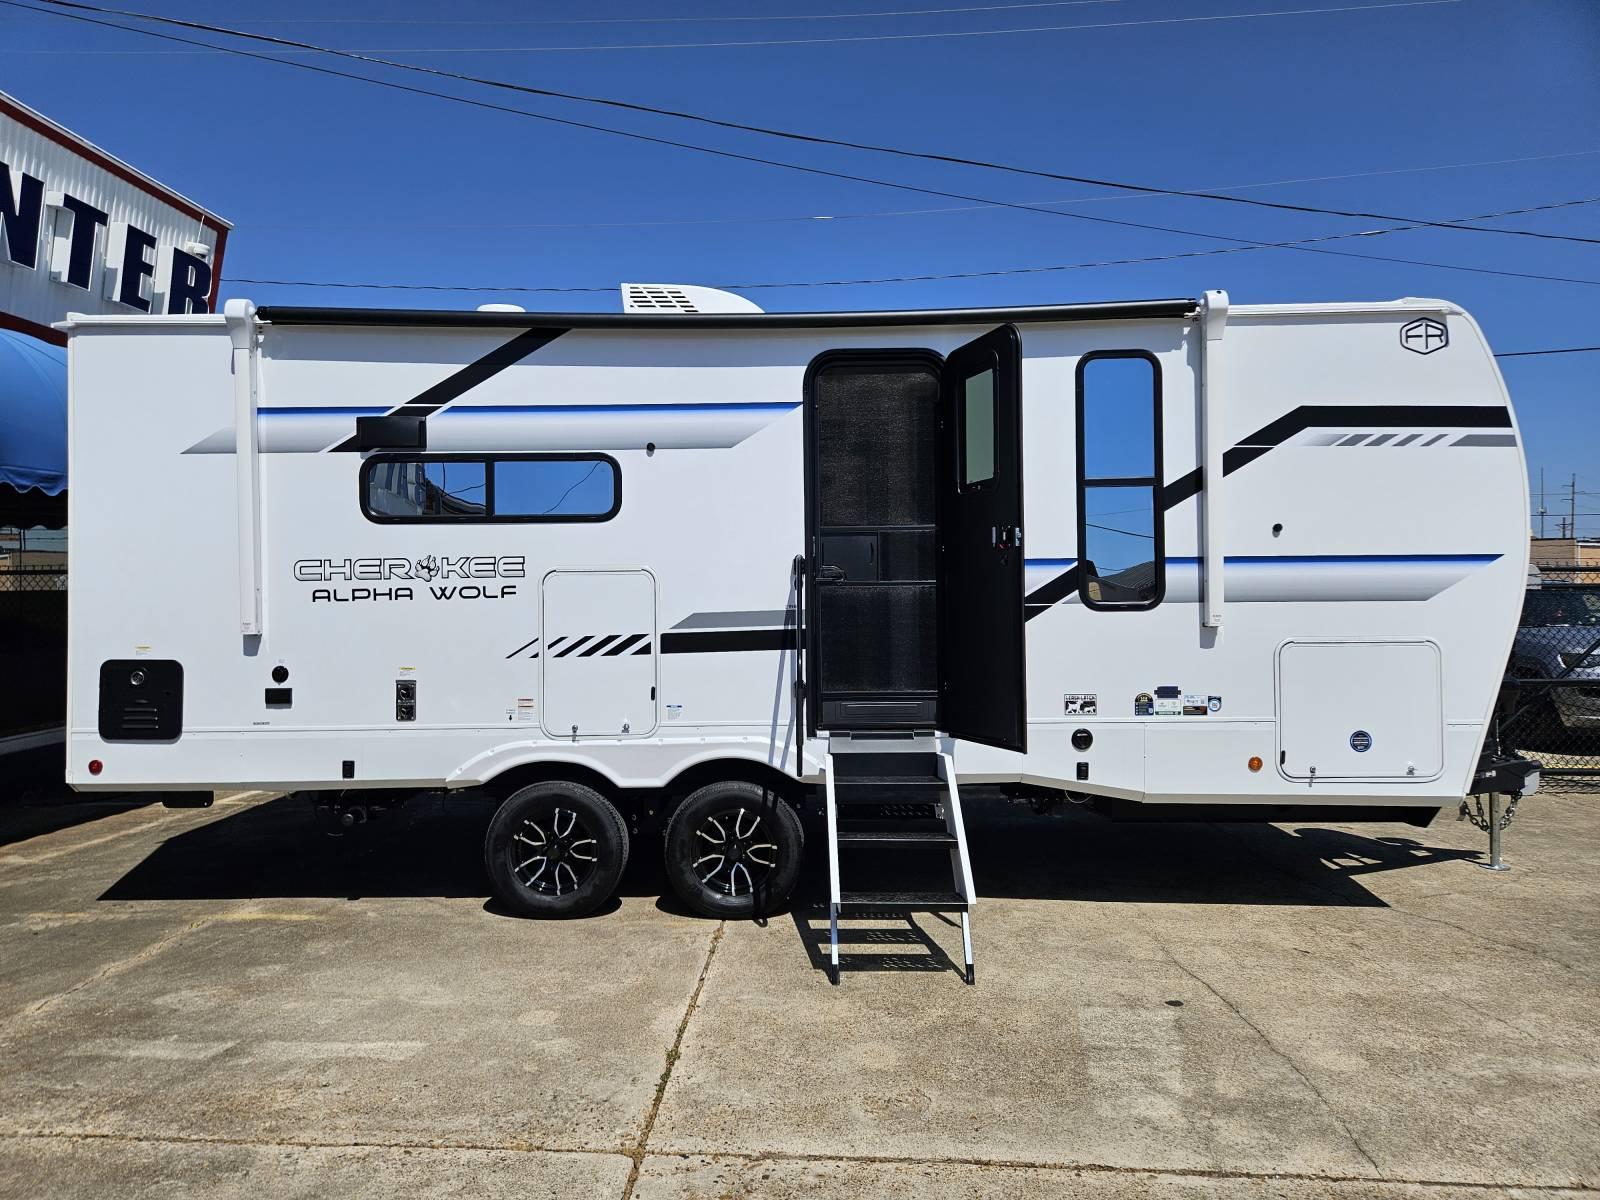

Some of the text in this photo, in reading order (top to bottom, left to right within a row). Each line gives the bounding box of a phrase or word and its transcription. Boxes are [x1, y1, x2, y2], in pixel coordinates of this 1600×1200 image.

[0, 160, 213, 315] NTER
[312, 585, 517, 603] ALPHA WOLF
